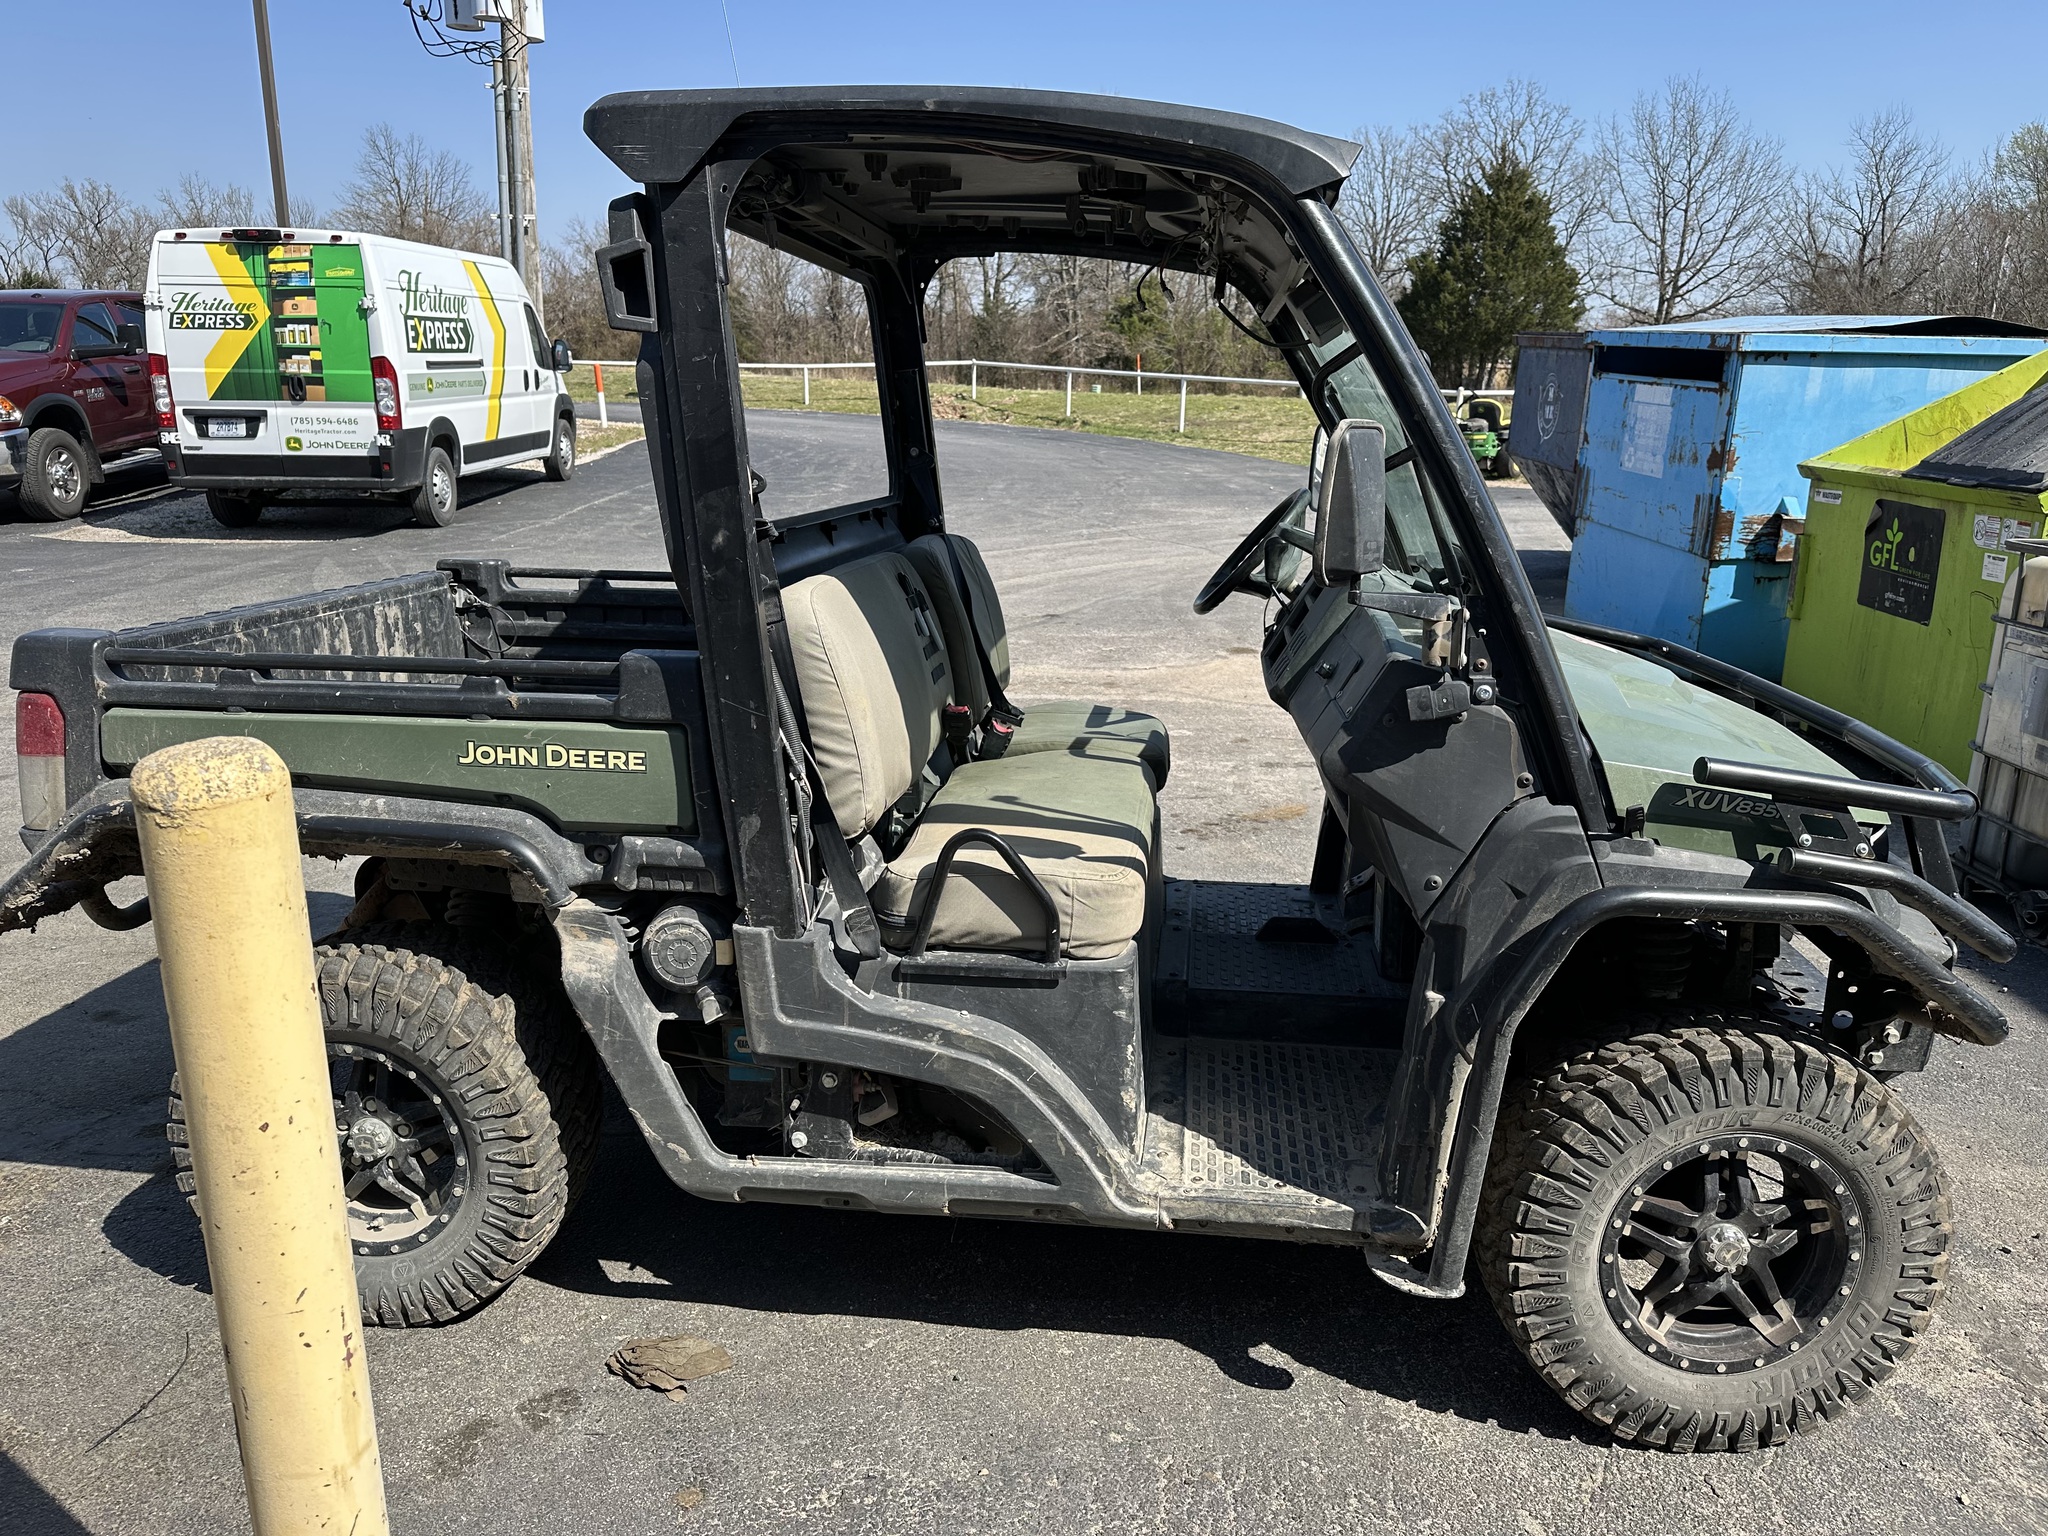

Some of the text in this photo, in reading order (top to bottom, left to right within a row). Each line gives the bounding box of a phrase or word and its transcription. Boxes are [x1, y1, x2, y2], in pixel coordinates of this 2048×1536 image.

[168, 291, 258, 314] Heritage
[398, 269, 469, 320] Heritage
[173, 314, 246, 329] EXPRESS
[406, 317, 467, 352] EXPRESS
[290, 416, 359, 426] (785) 594-6486
[306, 440, 370, 449] JOHN DEERE
[1869, 540, 1899, 571] GFL
[458, 741, 646, 771] JOHN DEERE
